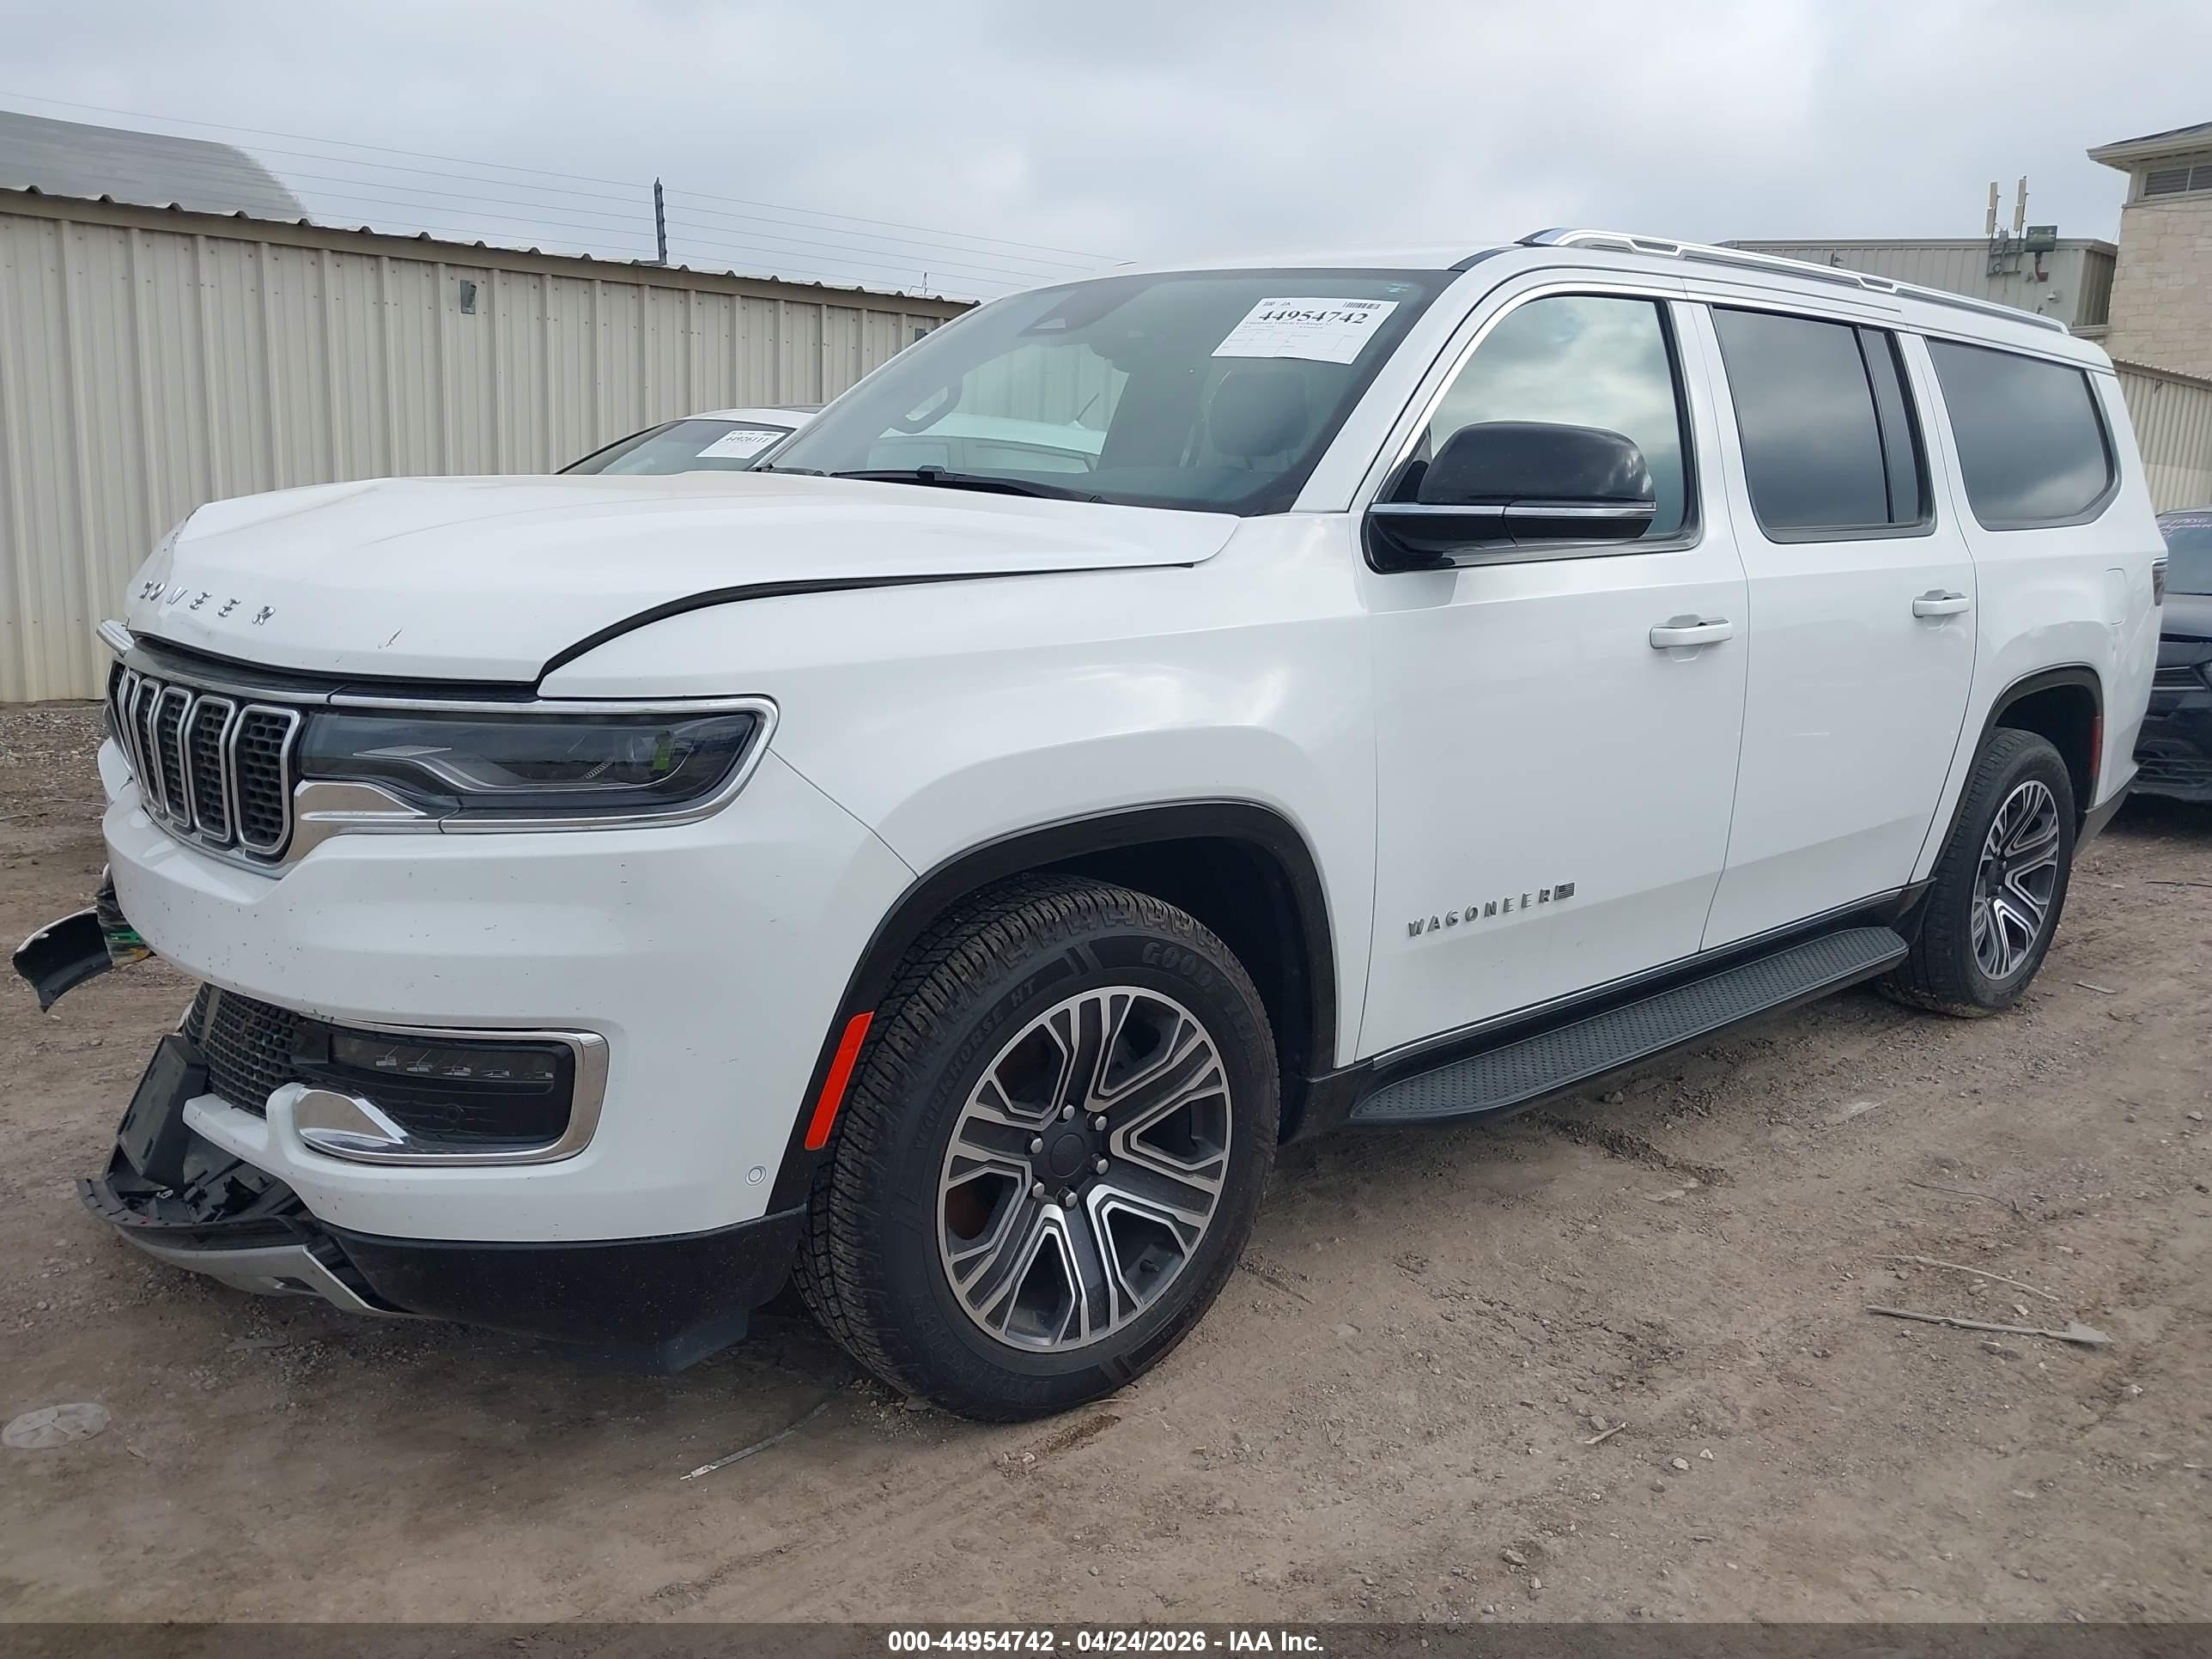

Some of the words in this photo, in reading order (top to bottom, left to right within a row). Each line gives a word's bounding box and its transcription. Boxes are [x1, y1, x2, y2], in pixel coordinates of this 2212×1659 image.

[1258, 310, 1369, 325] 44954742
[1407, 888, 1552, 938] WAGONEER
[914, 1003, 1004, 1150] WORKHORSE
[1009, 977, 1036, 1007] HT
